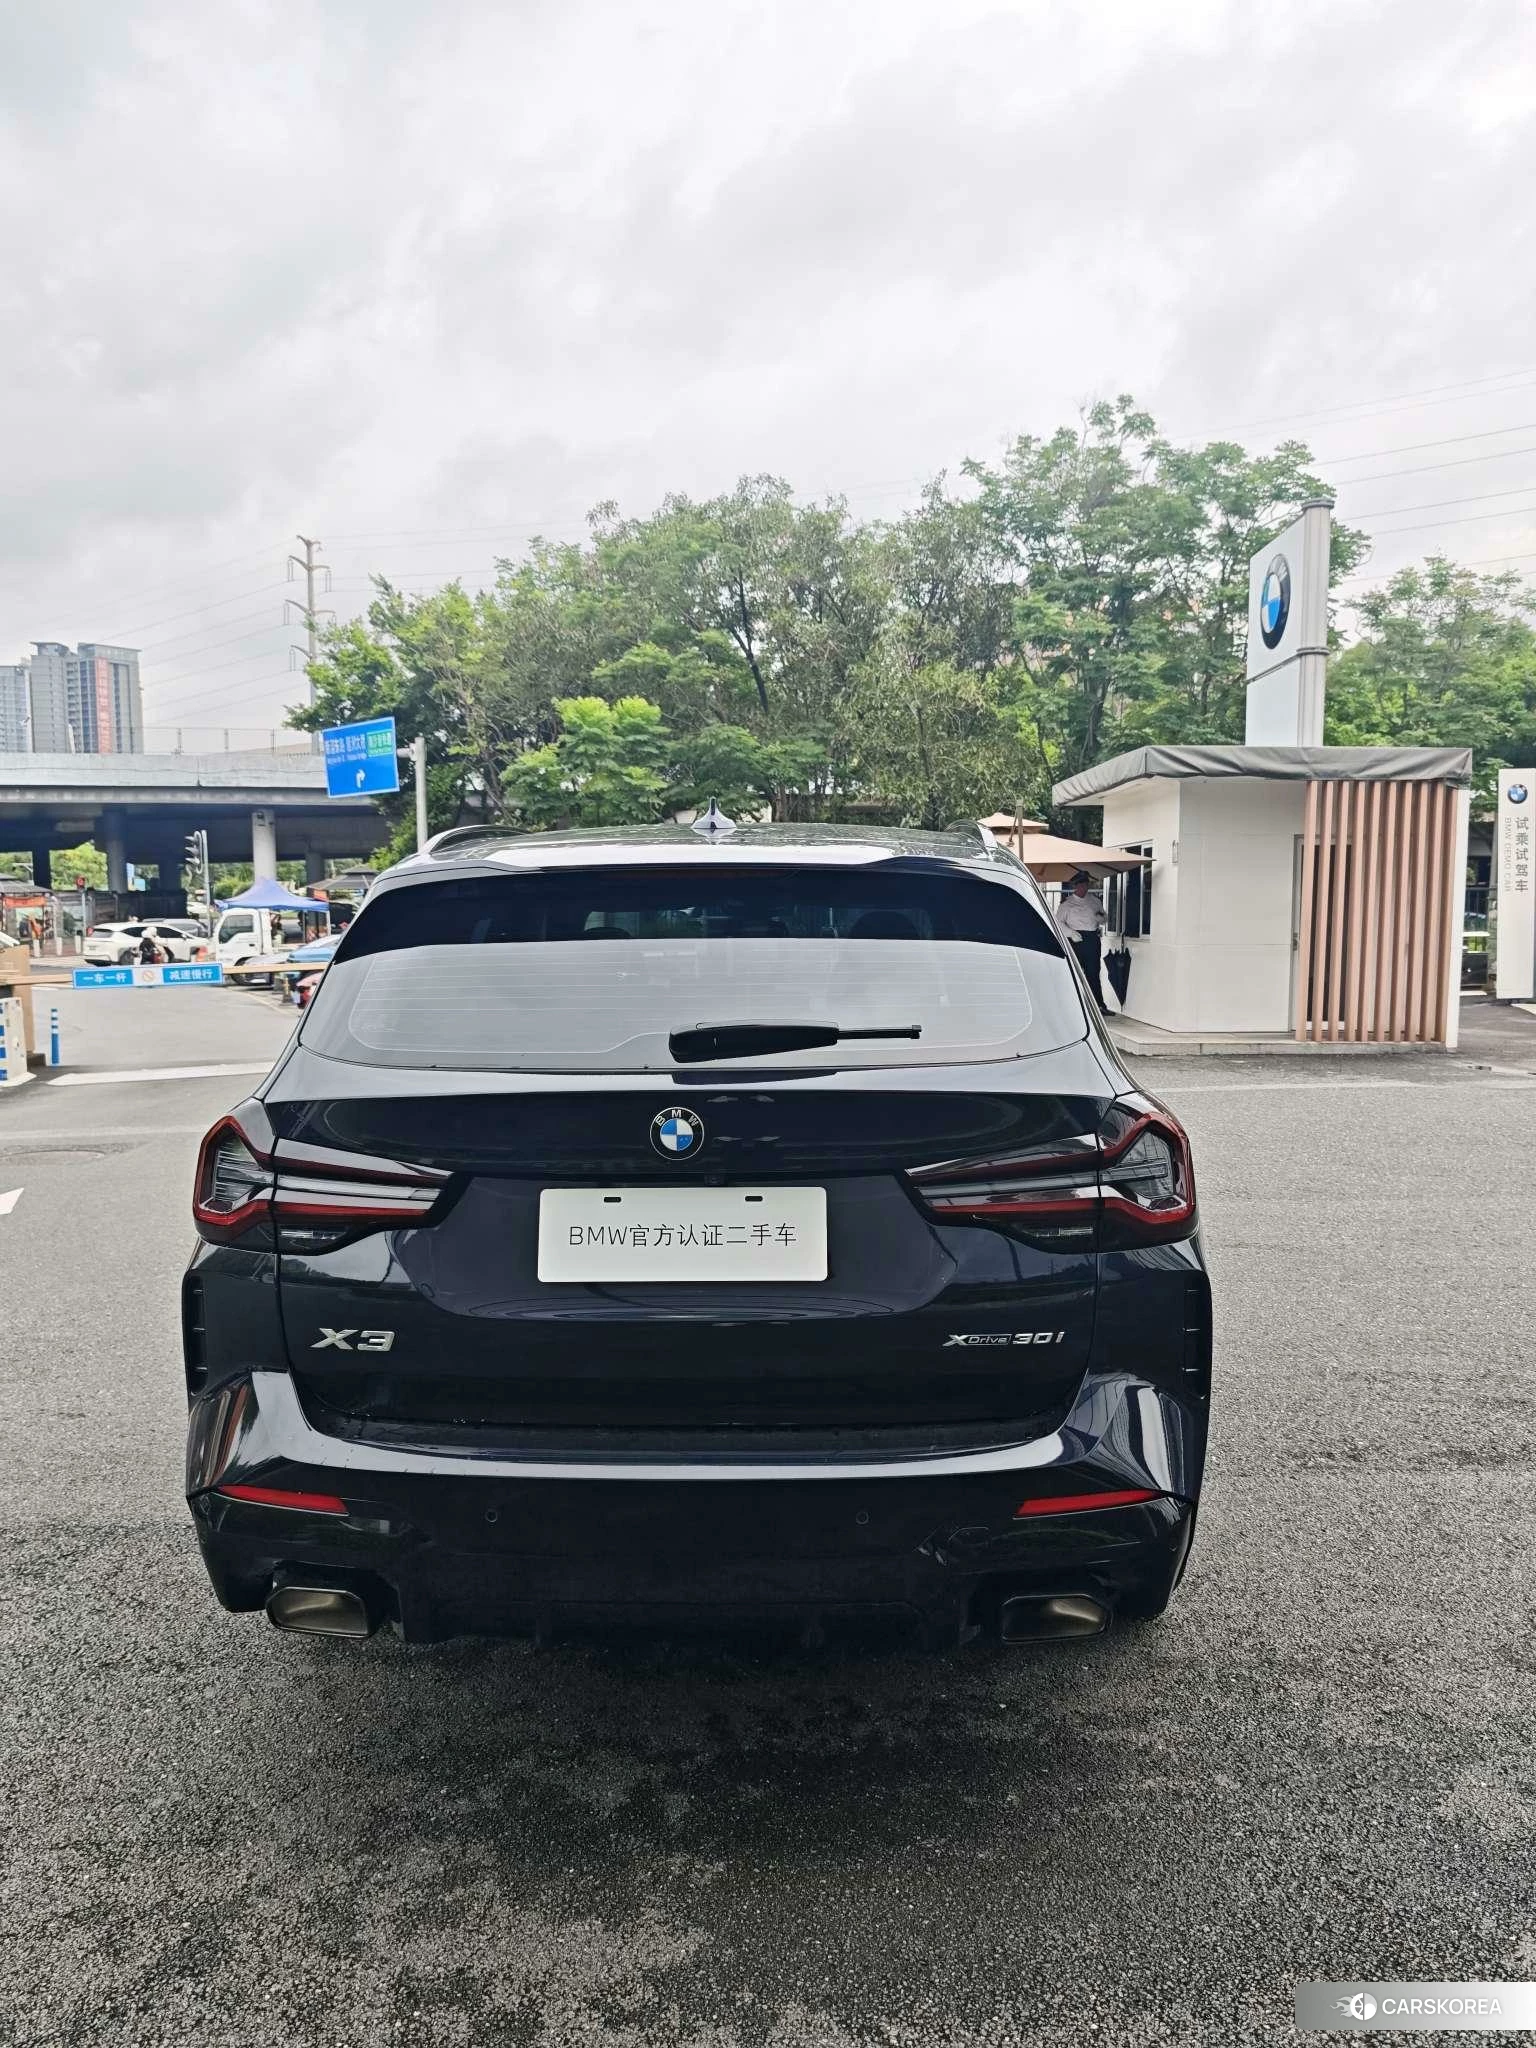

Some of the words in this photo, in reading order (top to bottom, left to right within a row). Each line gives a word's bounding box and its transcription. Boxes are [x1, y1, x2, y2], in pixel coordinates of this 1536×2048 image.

[1515, 817, 1529, 892] 试乘试驾车
[169, 968, 213, 981] 减速慢行
[568, 1222, 798, 1248] BMW官方认证二手车
[310, 1328, 395, 1352] X3
